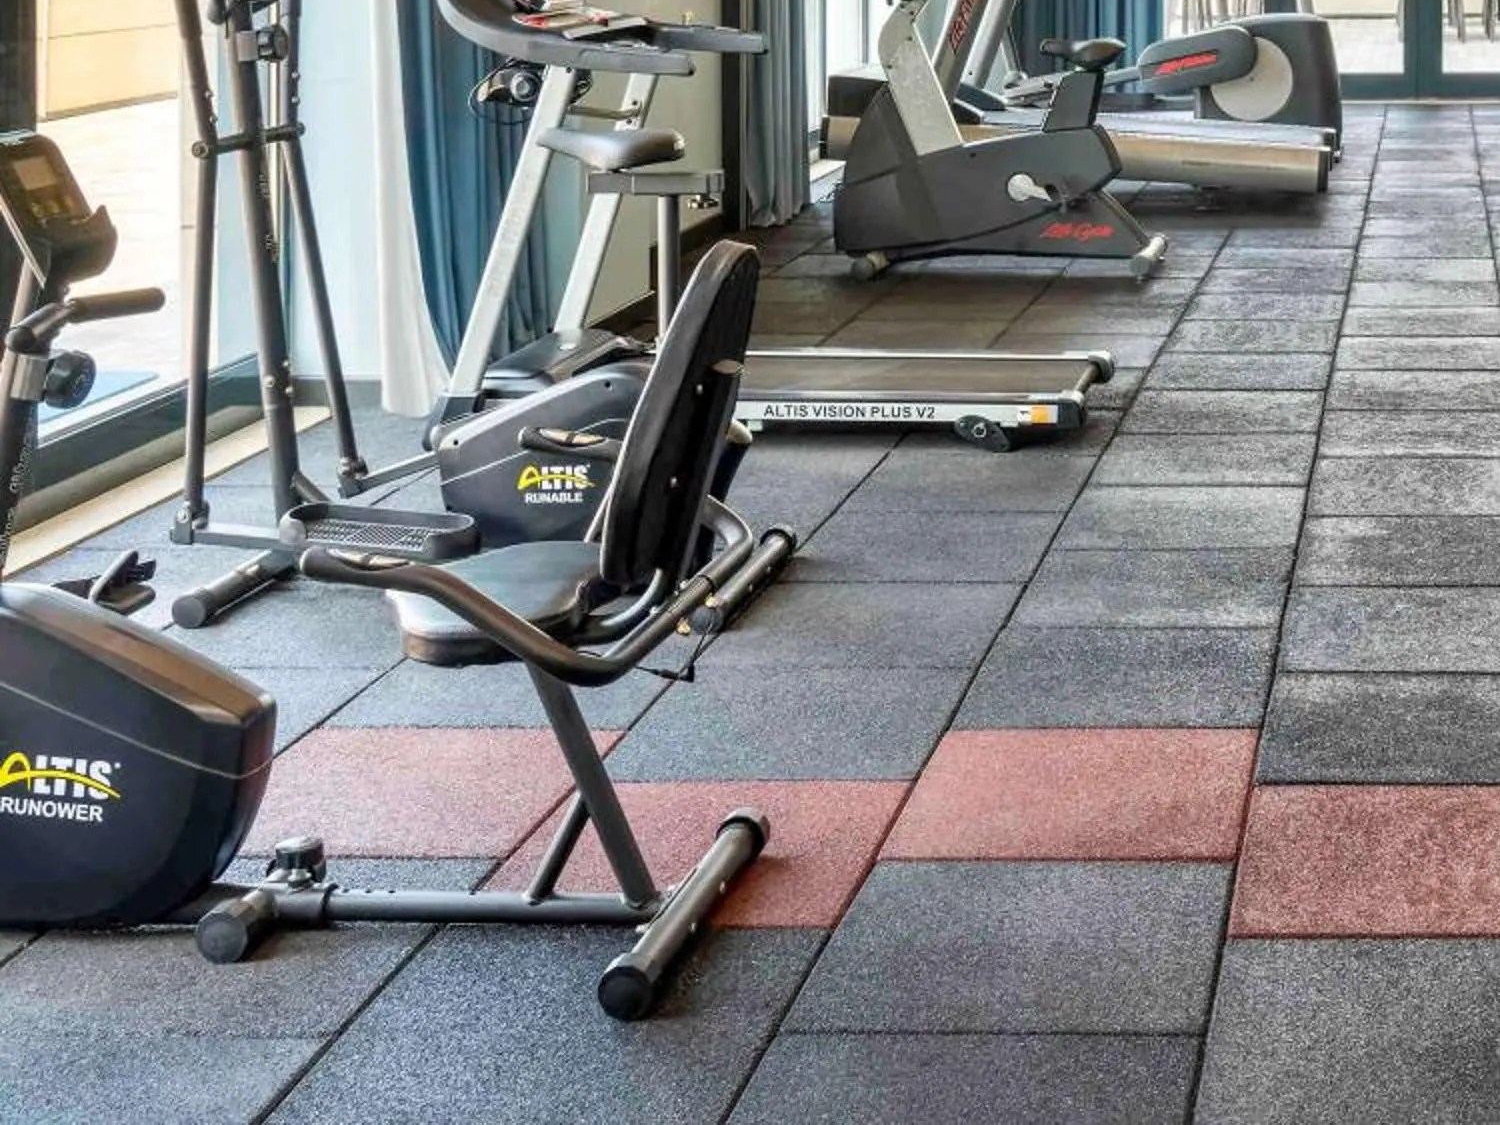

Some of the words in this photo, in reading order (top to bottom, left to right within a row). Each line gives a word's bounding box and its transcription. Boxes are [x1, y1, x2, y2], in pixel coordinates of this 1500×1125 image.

[763, 405, 808, 420] ALTIS
[812, 405, 866, 420] VISION
[870, 405, 912, 420] PLUS
[917, 406, 936, 420] V2
[517, 465, 596, 490] ALTIS
[525, 491, 584, 504] RUNABLE
